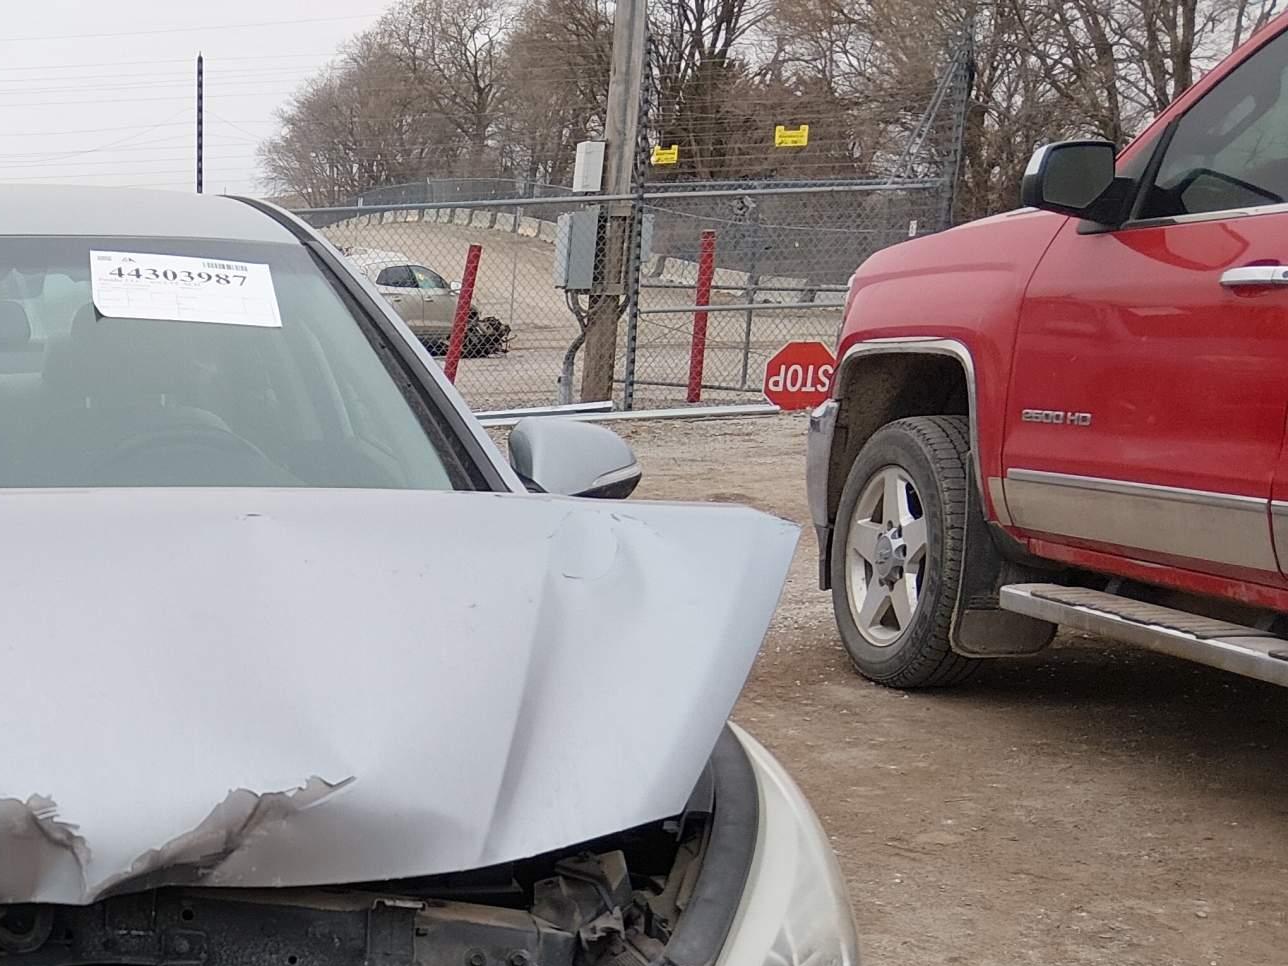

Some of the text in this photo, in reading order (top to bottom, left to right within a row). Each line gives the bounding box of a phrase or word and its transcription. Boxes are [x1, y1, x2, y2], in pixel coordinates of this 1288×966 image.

[108, 265, 248, 287] 44303987
[768, 364, 833, 392] STOP
[1066, 412, 1092, 426] HD
